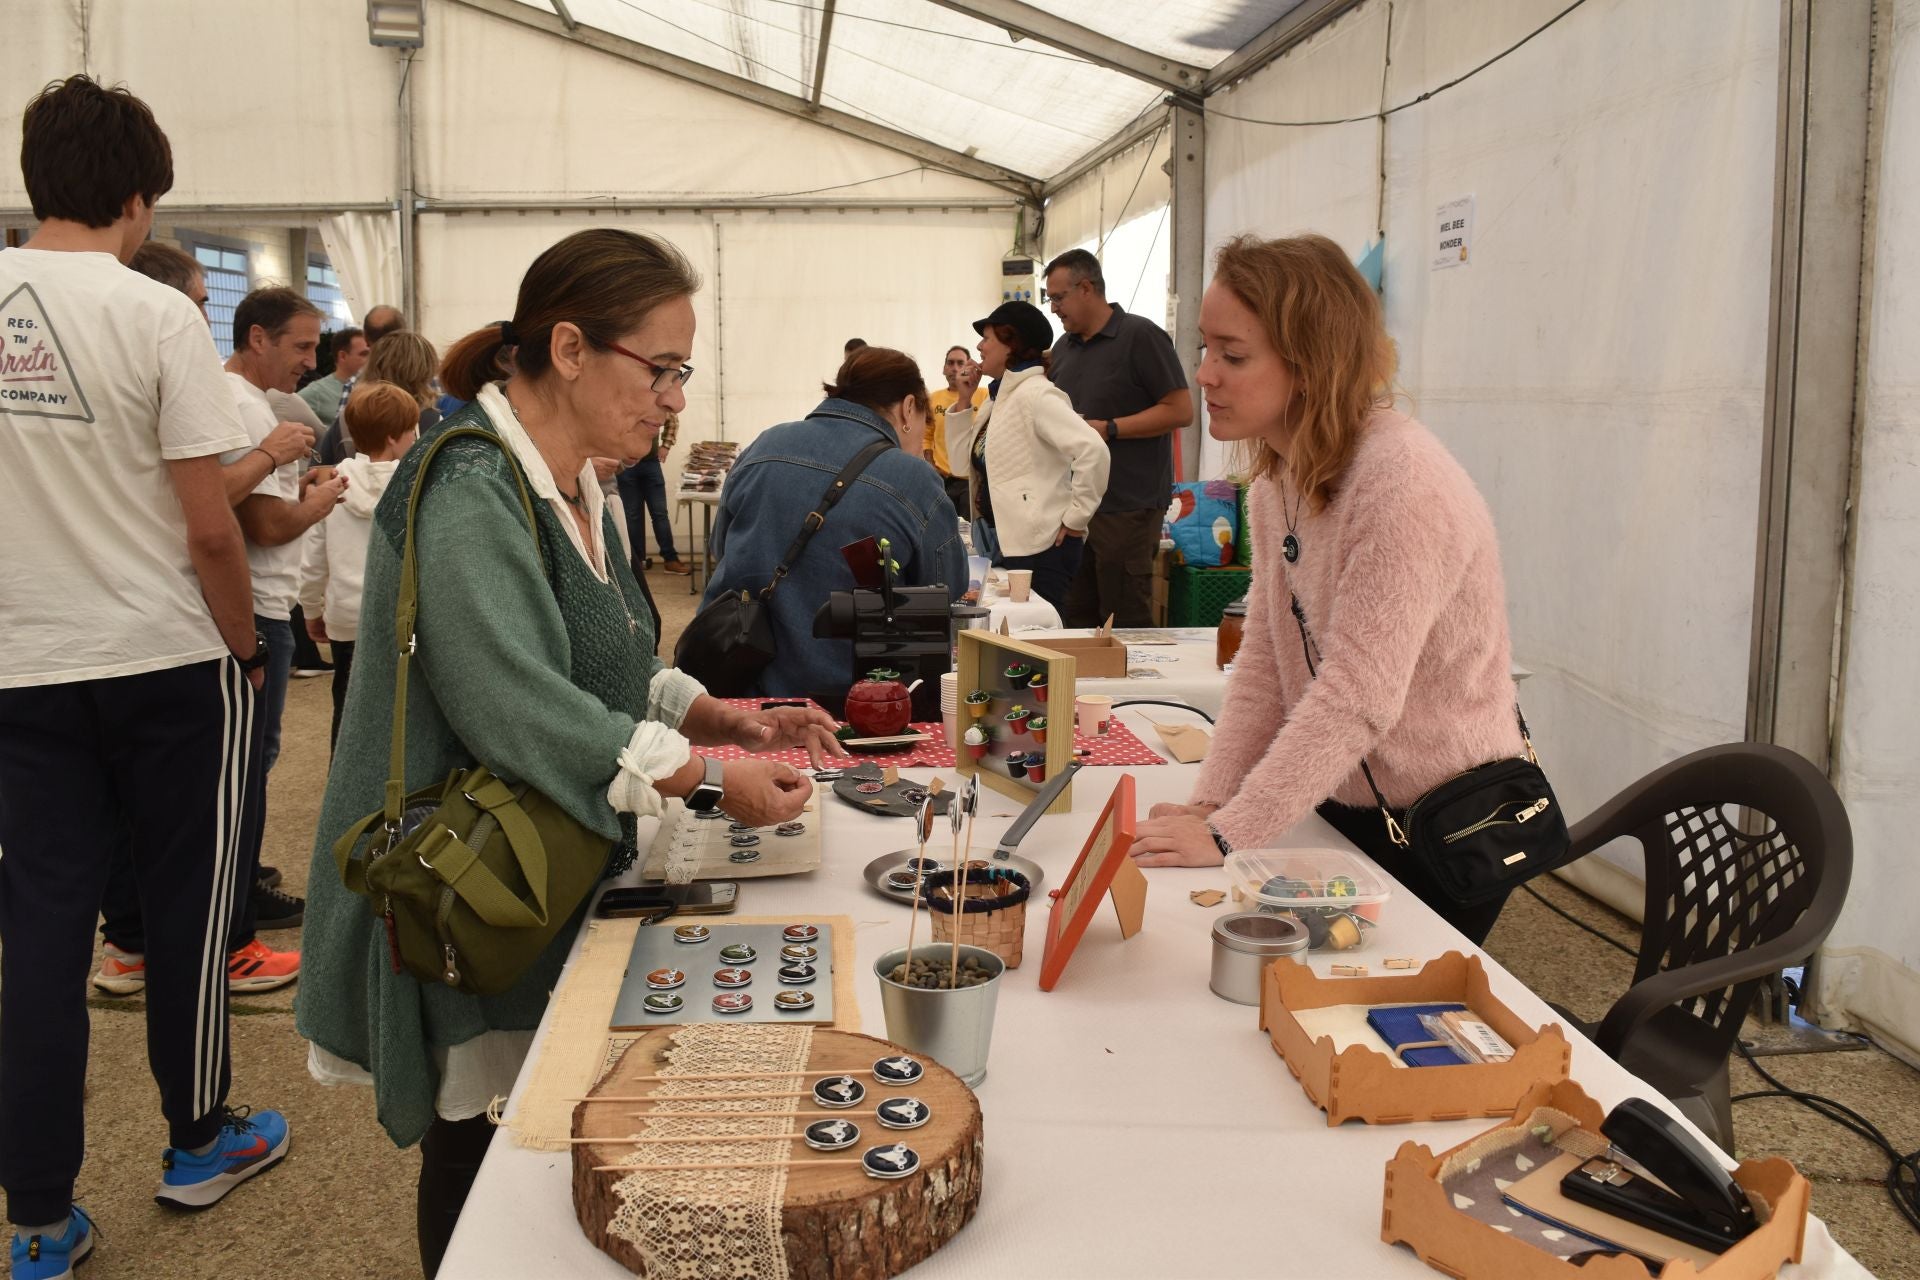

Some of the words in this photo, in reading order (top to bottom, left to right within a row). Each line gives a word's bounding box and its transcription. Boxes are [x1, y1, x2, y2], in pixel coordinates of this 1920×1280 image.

[1452, 219, 1465, 230] BEE
[7, 317, 38, 329] REG.
[13, 334, 28, 345] TM
[0, 389, 68, 405] COMPANY
